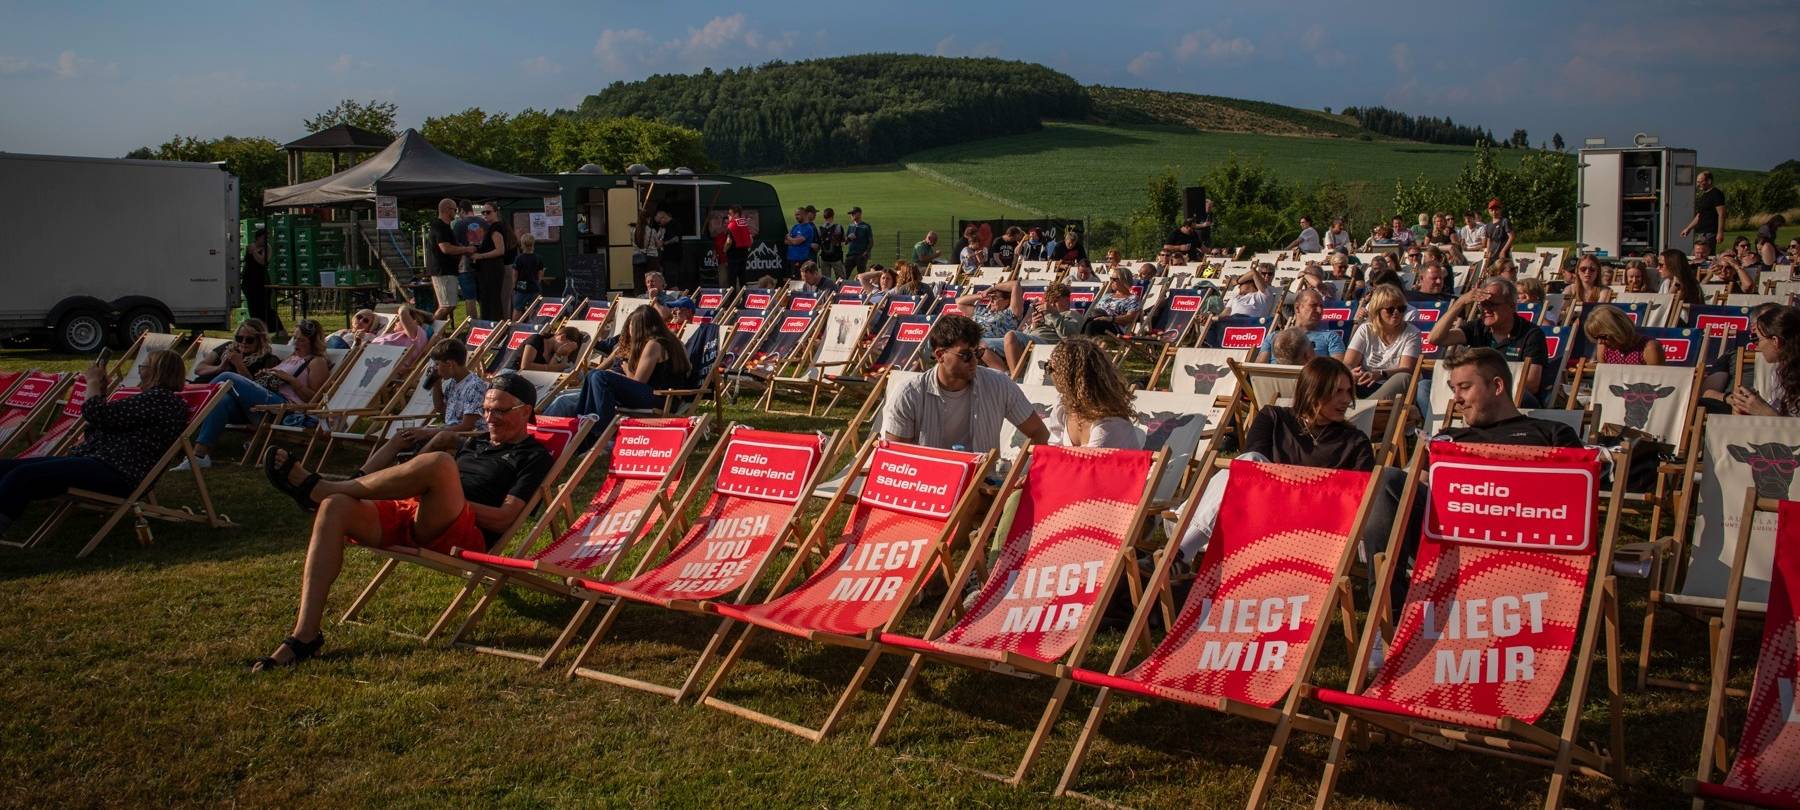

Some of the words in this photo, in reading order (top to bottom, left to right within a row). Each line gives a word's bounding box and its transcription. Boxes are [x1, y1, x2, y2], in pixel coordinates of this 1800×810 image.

[1322, 312, 1343, 320] adio
[1230, 332, 1257, 341] radio
[621, 435, 650, 445] radio
[619, 448, 672, 458] sauerland
[735, 453, 768, 465] radio
[730, 466, 795, 481] sauerland
[881, 461, 917, 476] radio
[876, 475, 948, 496] sauerland
[1449, 481, 1510, 498] radio
[1447, 500, 1568, 520] sauerland
[582, 510, 643, 537] LIEG
[706, 515, 770, 539] WISH
[704, 540, 752, 561] YOU
[838, 538, 929, 571] LIEGT
[680, 559, 751, 579] WERE
[664, 578, 735, 592] HEAR
[828, 576, 904, 602] MIR
[1003, 560, 1104, 601] LIEGT
[1000, 603, 1084, 633] MIR
[1198, 594, 1310, 633] LIEGT
[1423, 592, 1549, 641] LIEGT
[1197, 640, 1289, 672] MIR
[1433, 645, 1536, 684] MIR
